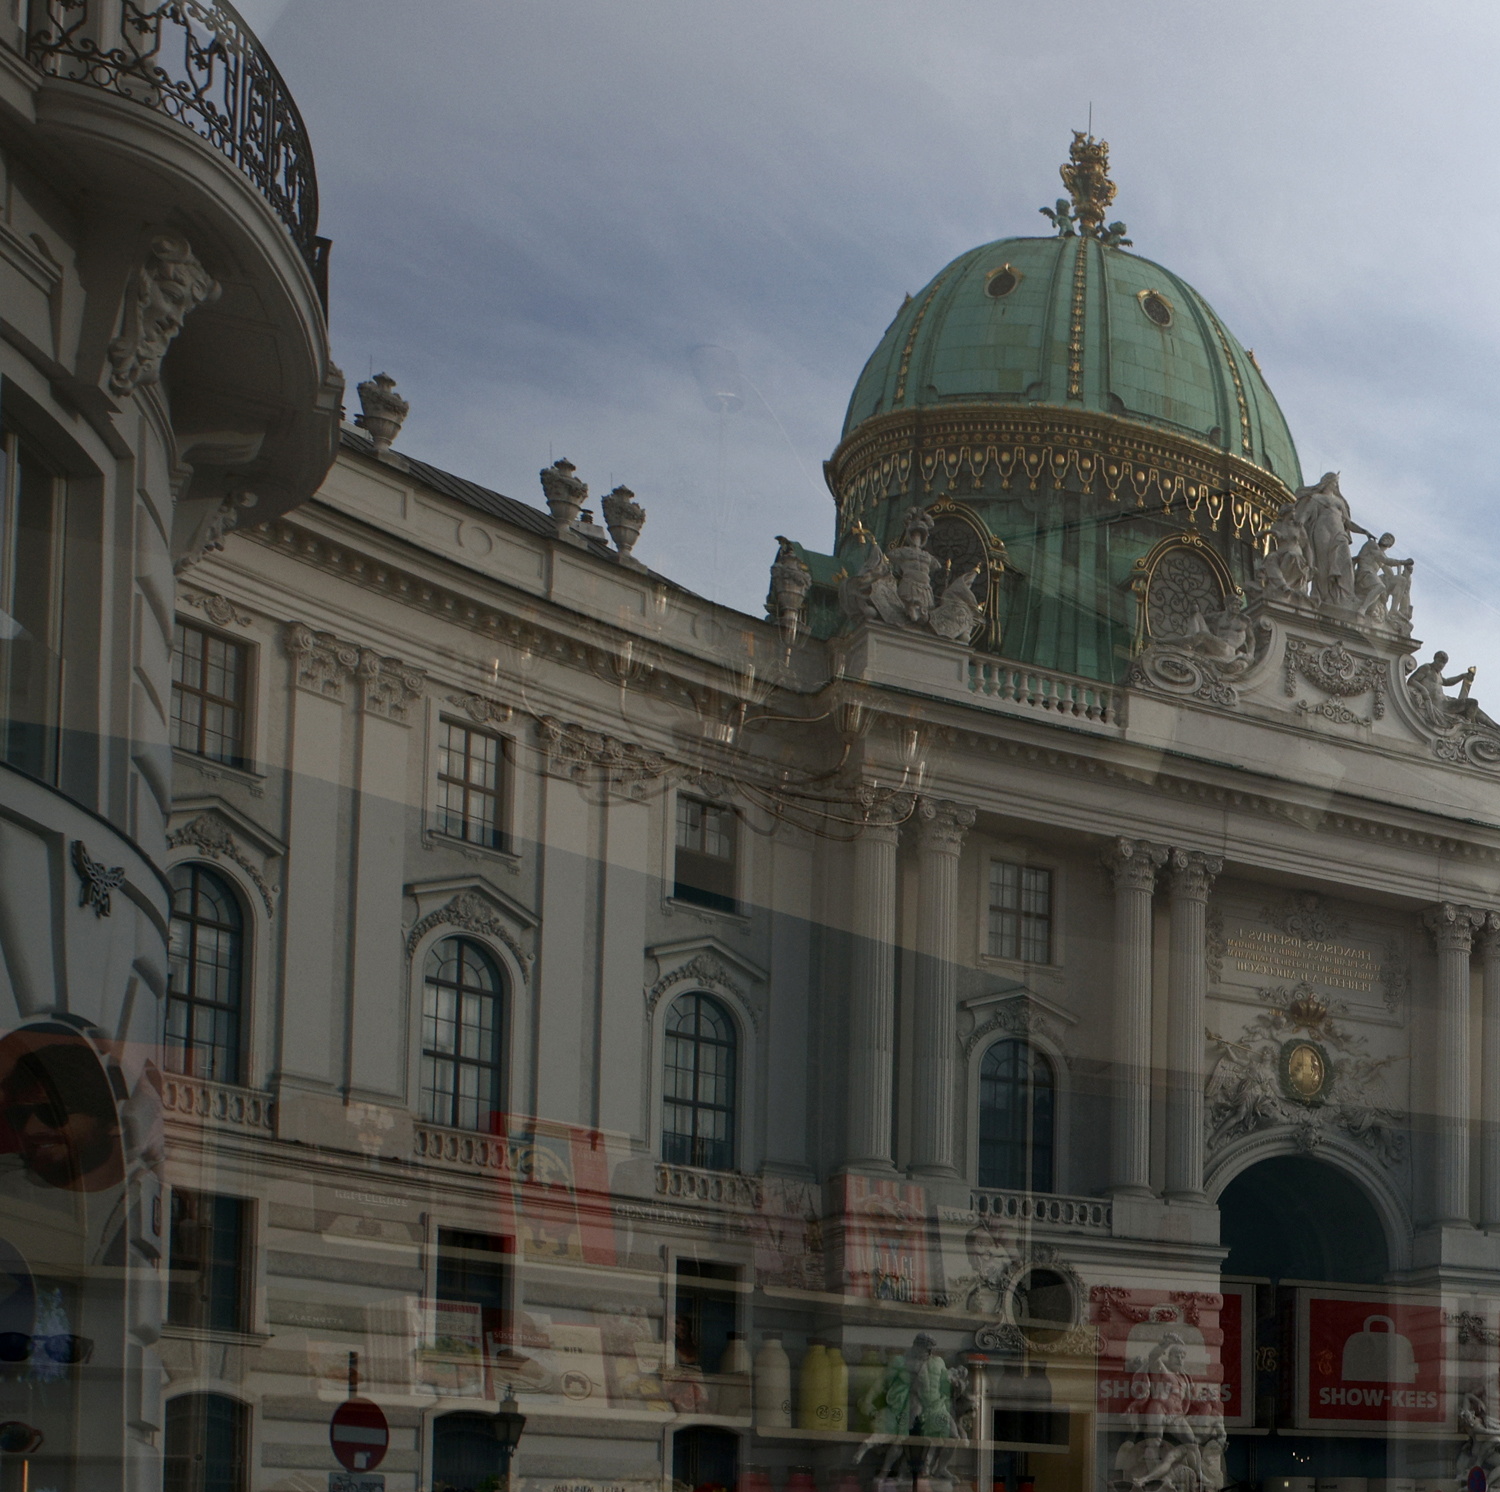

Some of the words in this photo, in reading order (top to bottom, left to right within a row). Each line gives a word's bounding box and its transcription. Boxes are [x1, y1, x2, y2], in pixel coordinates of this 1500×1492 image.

[614, 1203, 705, 1228] GENTLEMAN
[943, 1210, 975, 1223] VELO
[1100, 1380, 1232, 1402] SHOW-KEES
[1319, 1387, 1438, 1409] SHOW-KEES
